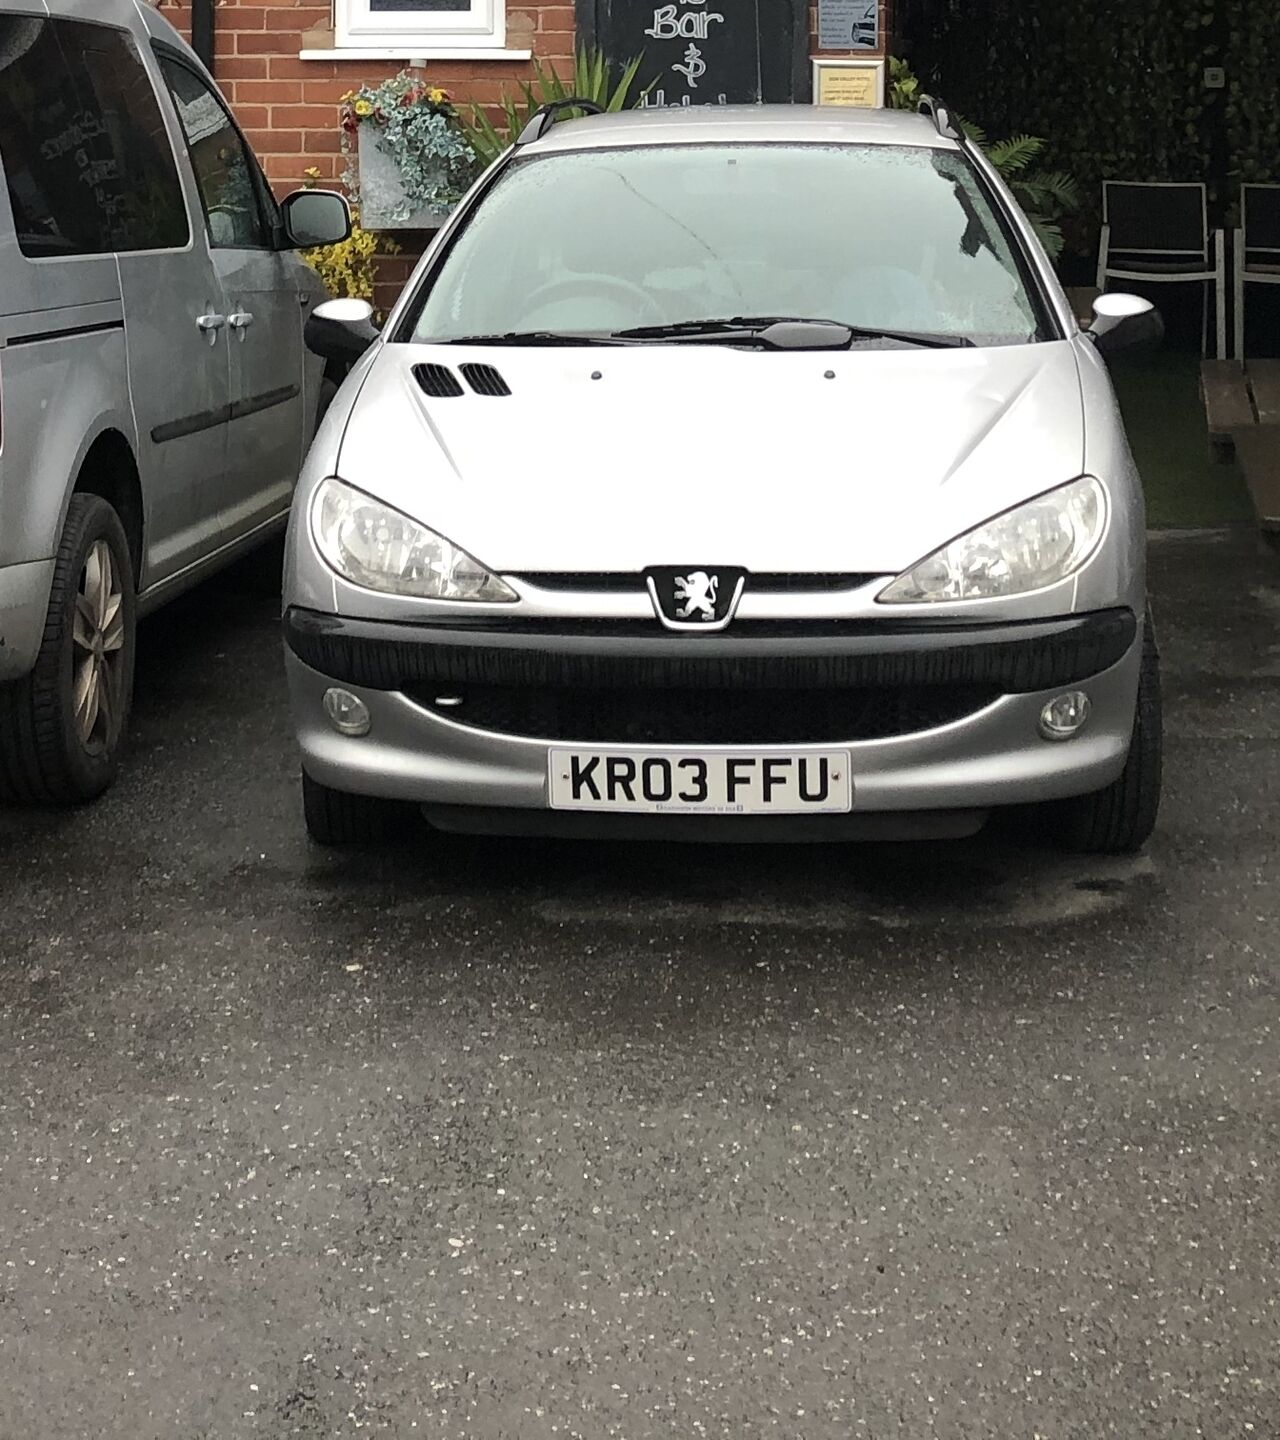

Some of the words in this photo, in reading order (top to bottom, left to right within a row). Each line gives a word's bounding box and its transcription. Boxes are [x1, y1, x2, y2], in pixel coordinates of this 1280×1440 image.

[645, 5, 724, 39] Bar
[570, 756, 708, 802] KR03
[726, 758, 829, 803] FFU
